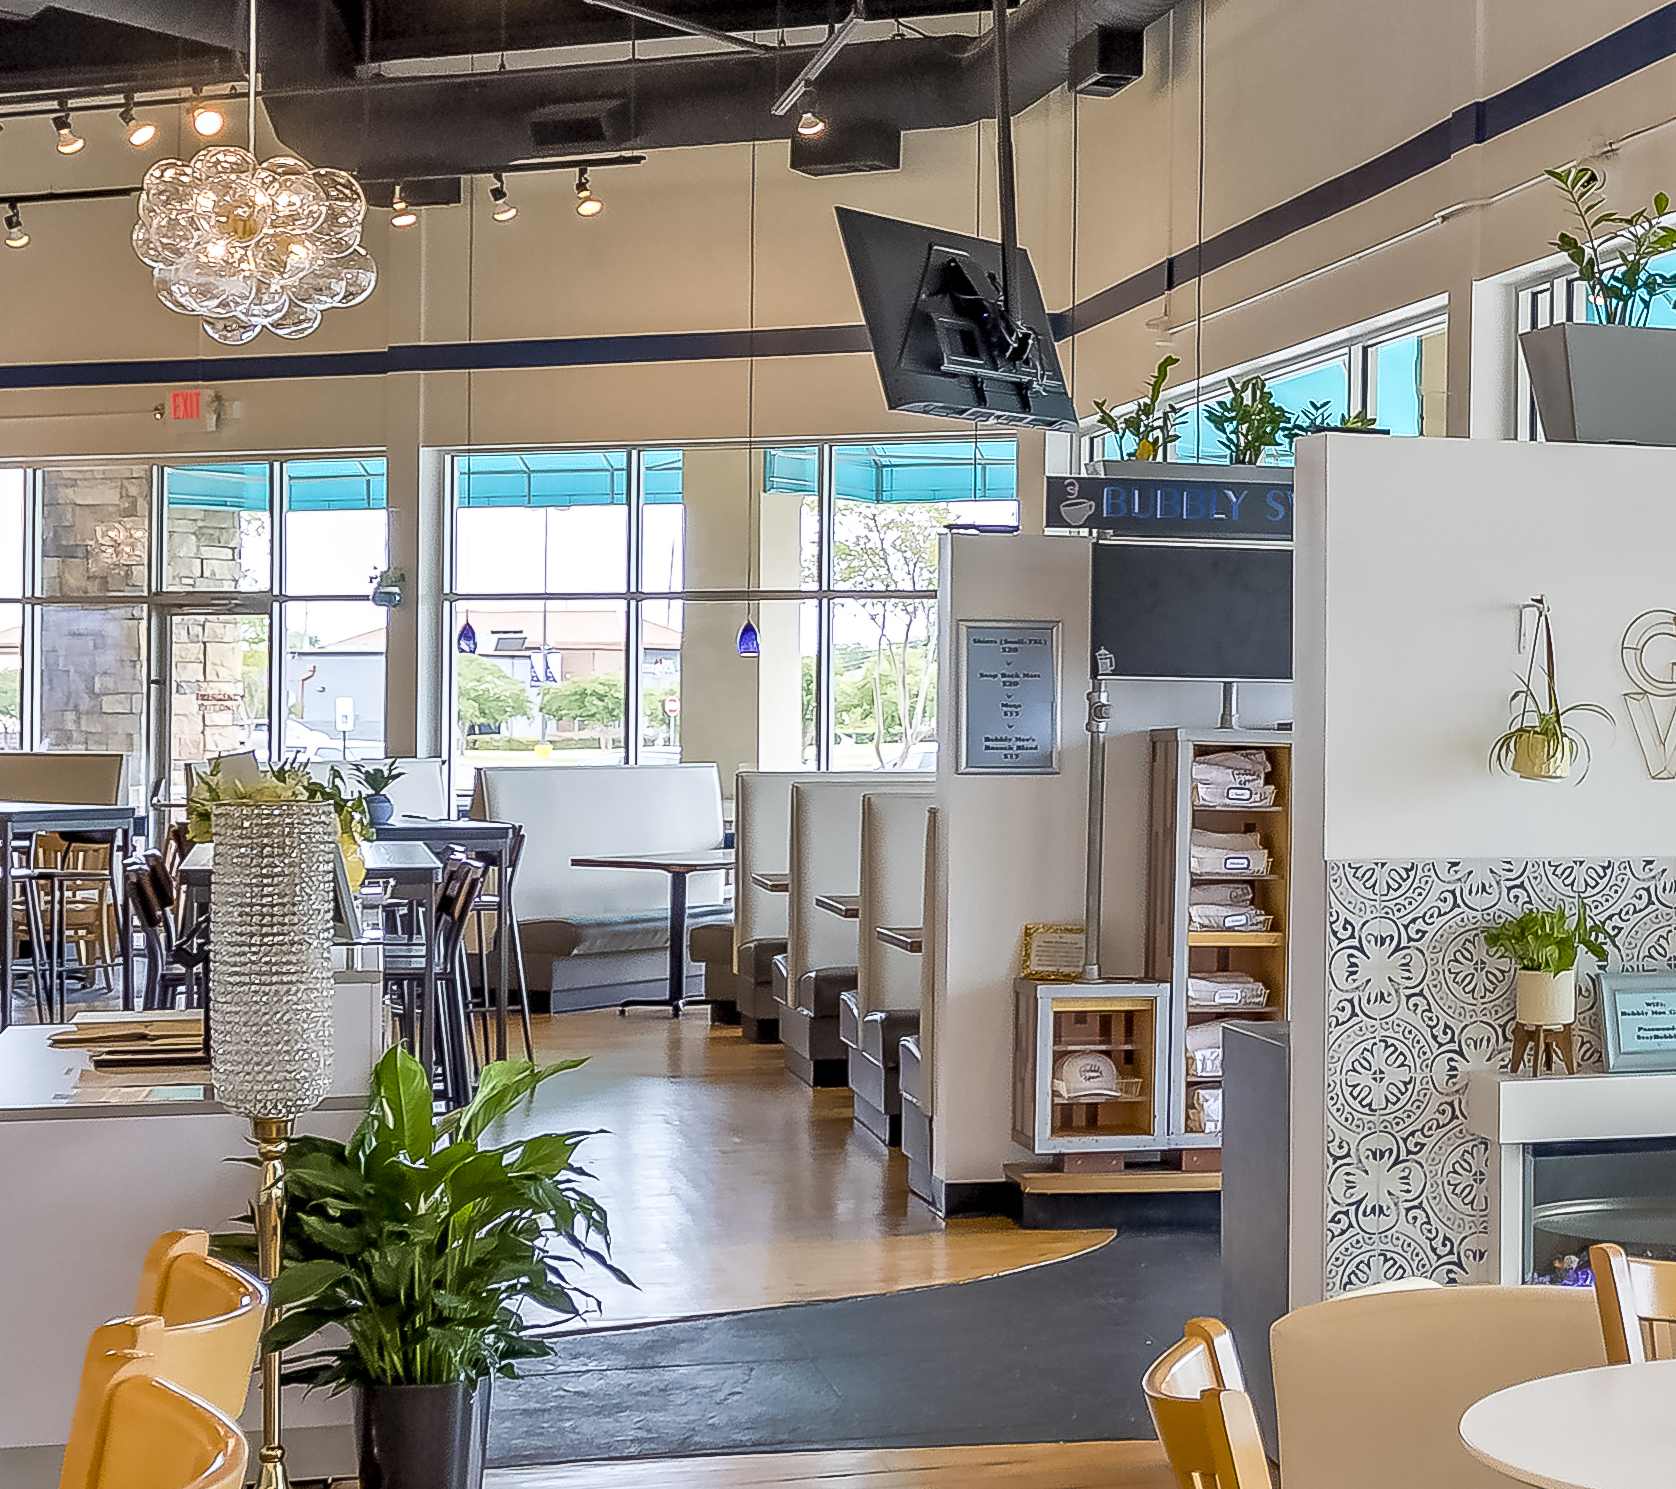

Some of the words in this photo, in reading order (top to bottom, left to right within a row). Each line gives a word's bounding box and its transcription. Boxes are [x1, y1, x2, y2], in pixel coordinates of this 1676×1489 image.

[171, 391, 200, 420] EXIT
[1103, 485, 1248, 521] BUBBLY
[1266, 489, 1293, 522] S
